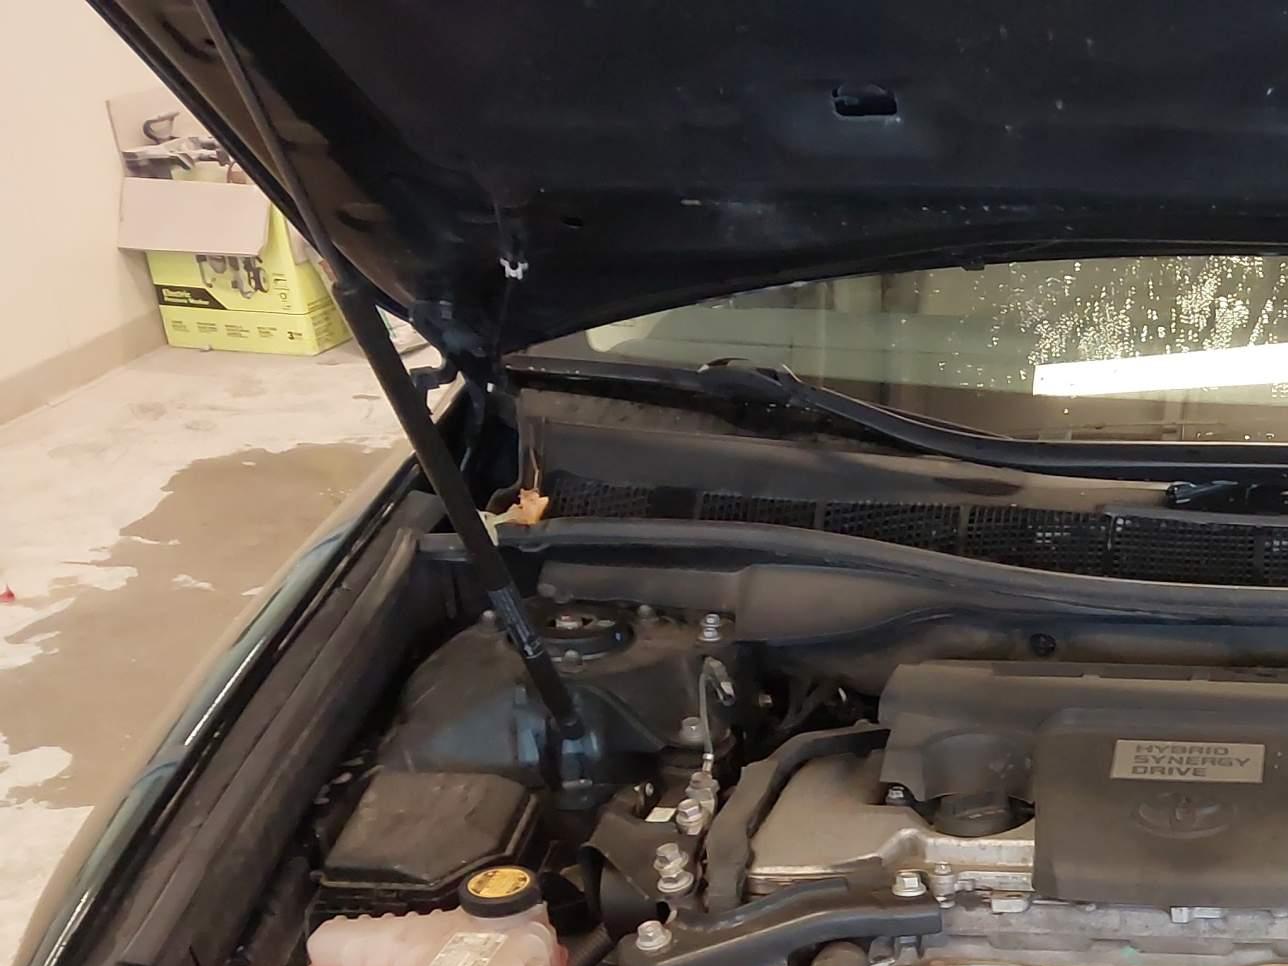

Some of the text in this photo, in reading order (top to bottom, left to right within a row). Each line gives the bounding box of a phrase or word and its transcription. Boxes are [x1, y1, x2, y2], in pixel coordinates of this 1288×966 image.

[1136, 744, 1229, 756] HYBRID
[1133, 754, 1251, 768] SYNERGY
[1131, 765, 1207, 777] DRIVE
